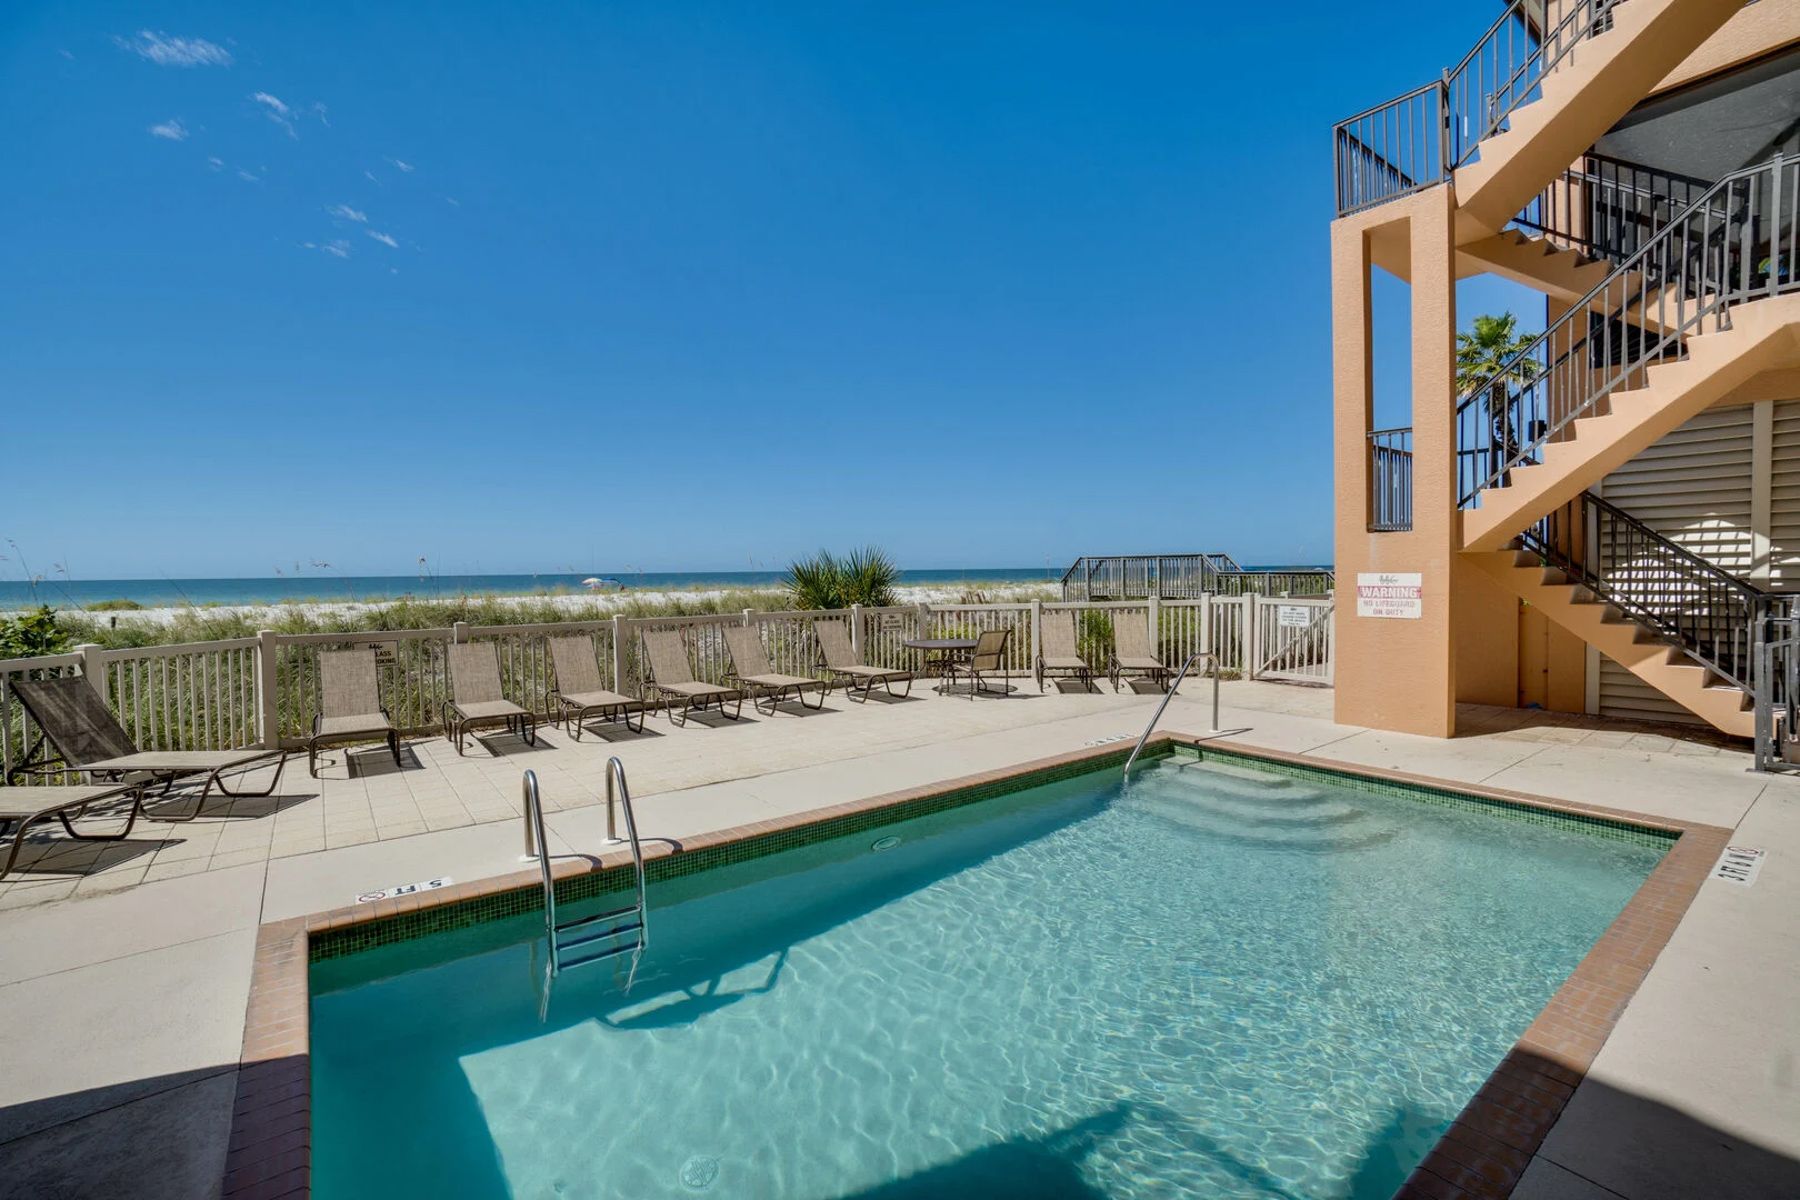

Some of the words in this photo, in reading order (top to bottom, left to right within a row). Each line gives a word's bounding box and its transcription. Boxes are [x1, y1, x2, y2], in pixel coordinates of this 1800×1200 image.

[1360, 587, 1418, 598] WARNING
[1376, 600, 1415, 608] LIFEGUARD
[429, 879, 442, 888] 5
[395, 885, 416, 896] FT
